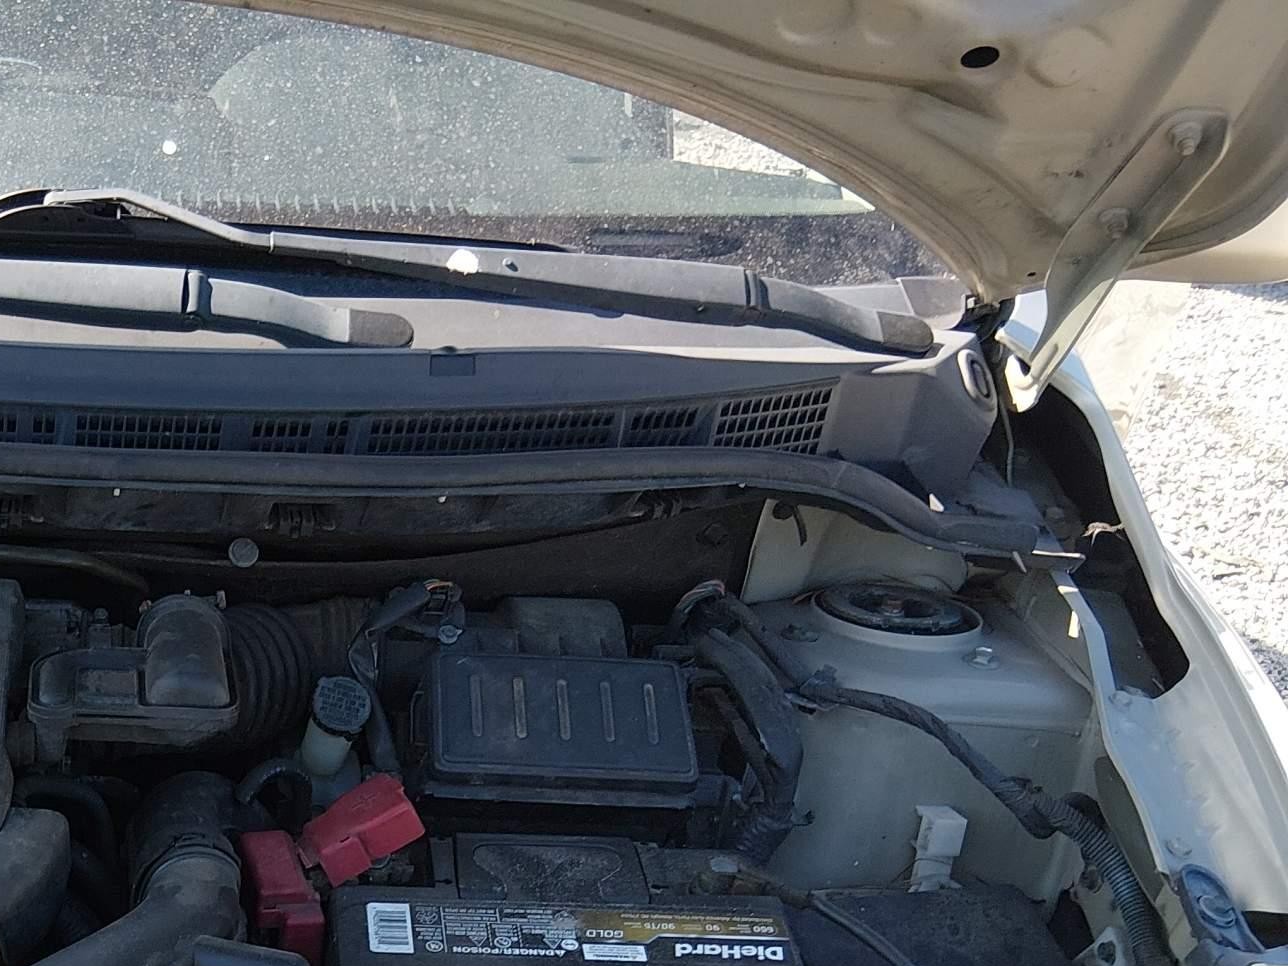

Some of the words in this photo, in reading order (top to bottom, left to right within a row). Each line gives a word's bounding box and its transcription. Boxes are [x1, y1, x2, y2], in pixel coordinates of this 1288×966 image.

[705, 924, 721, 932] 90
[753, 925, 775, 934] 660
[584, 929, 624, 938] GOLD
[452, 945, 556, 956] DANGER/POISON
[674, 943, 784, 961] DieHard
